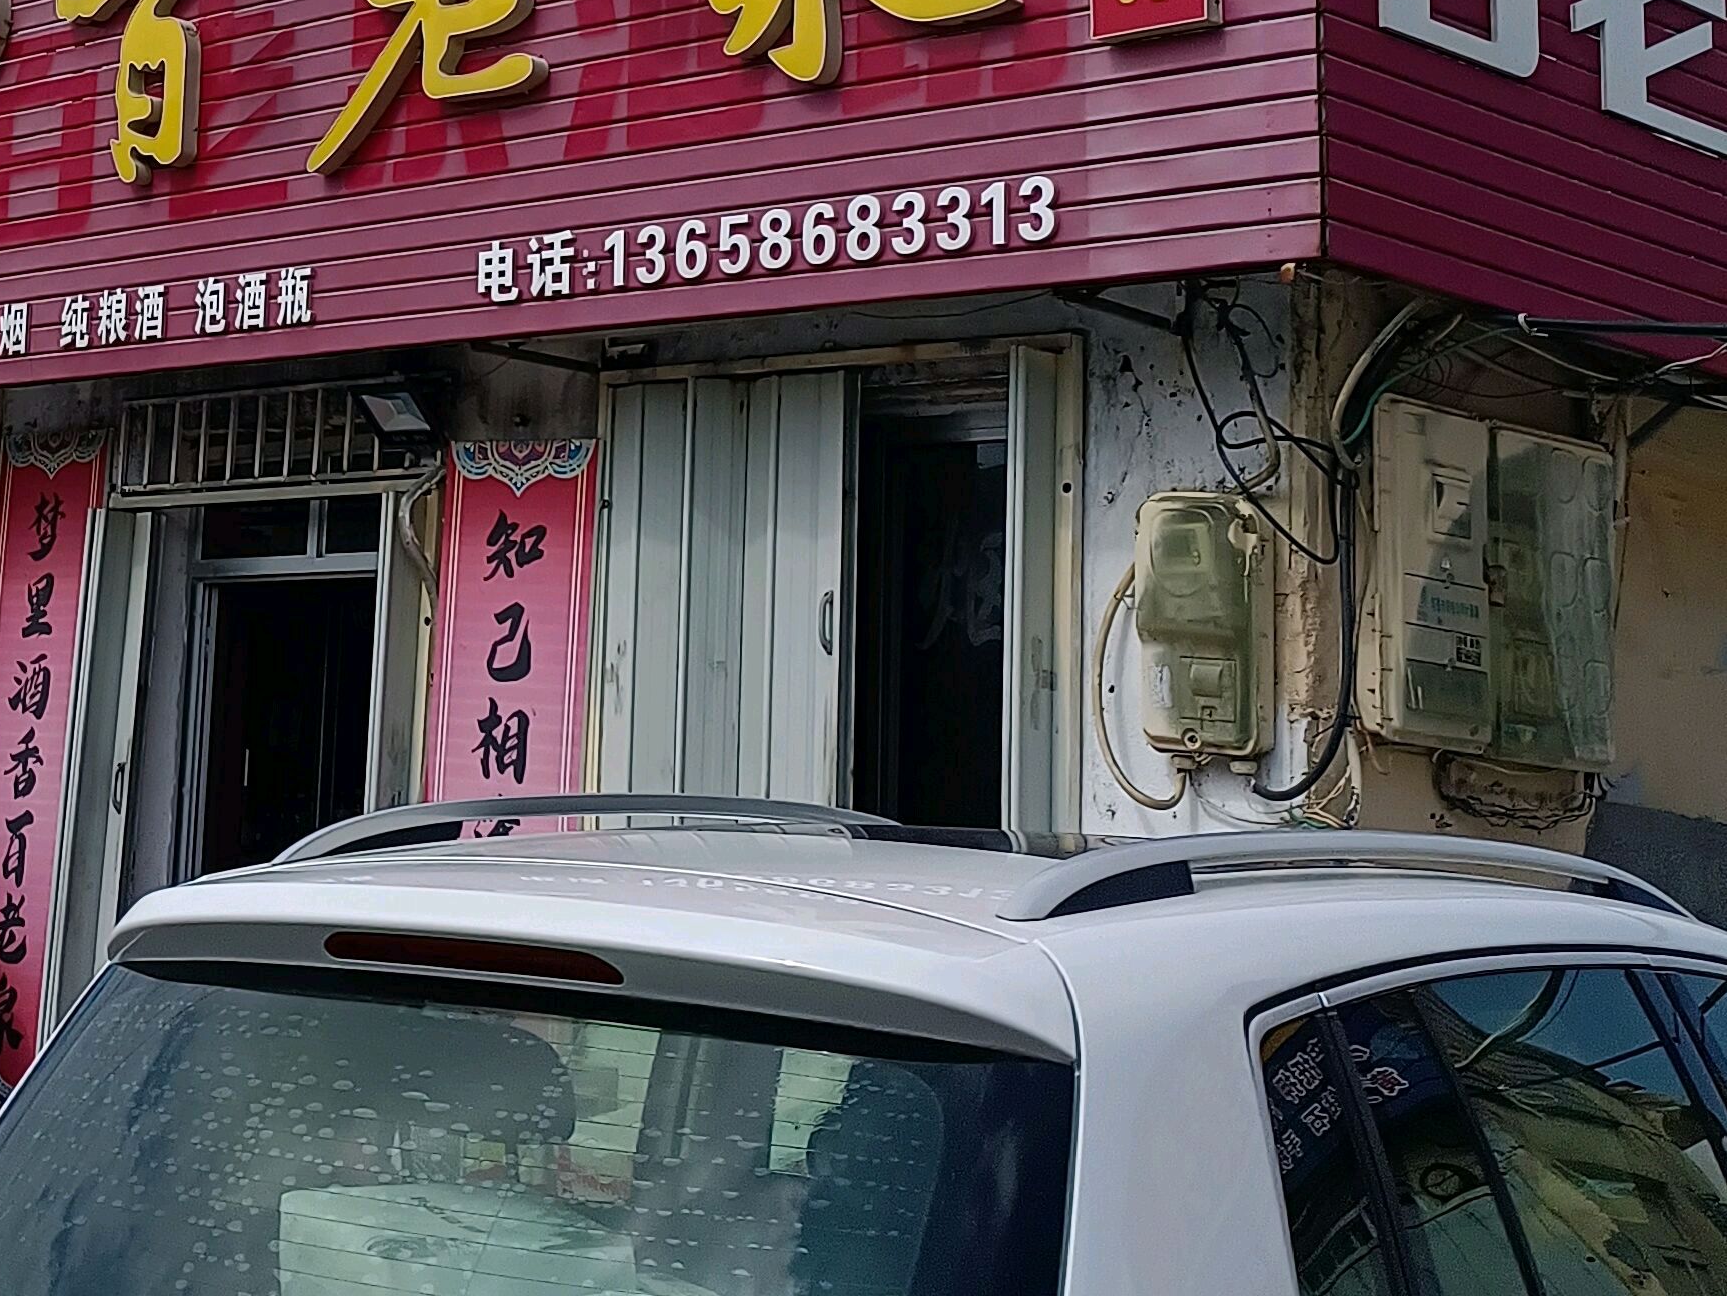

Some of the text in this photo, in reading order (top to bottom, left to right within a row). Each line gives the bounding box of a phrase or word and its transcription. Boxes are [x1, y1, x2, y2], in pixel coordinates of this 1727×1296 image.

[477, 176, 1059, 302] 电话:13658683313
[60, 285, 164, 348] 纯粮酒
[195, 268, 313, 332] 泡酒瓶
